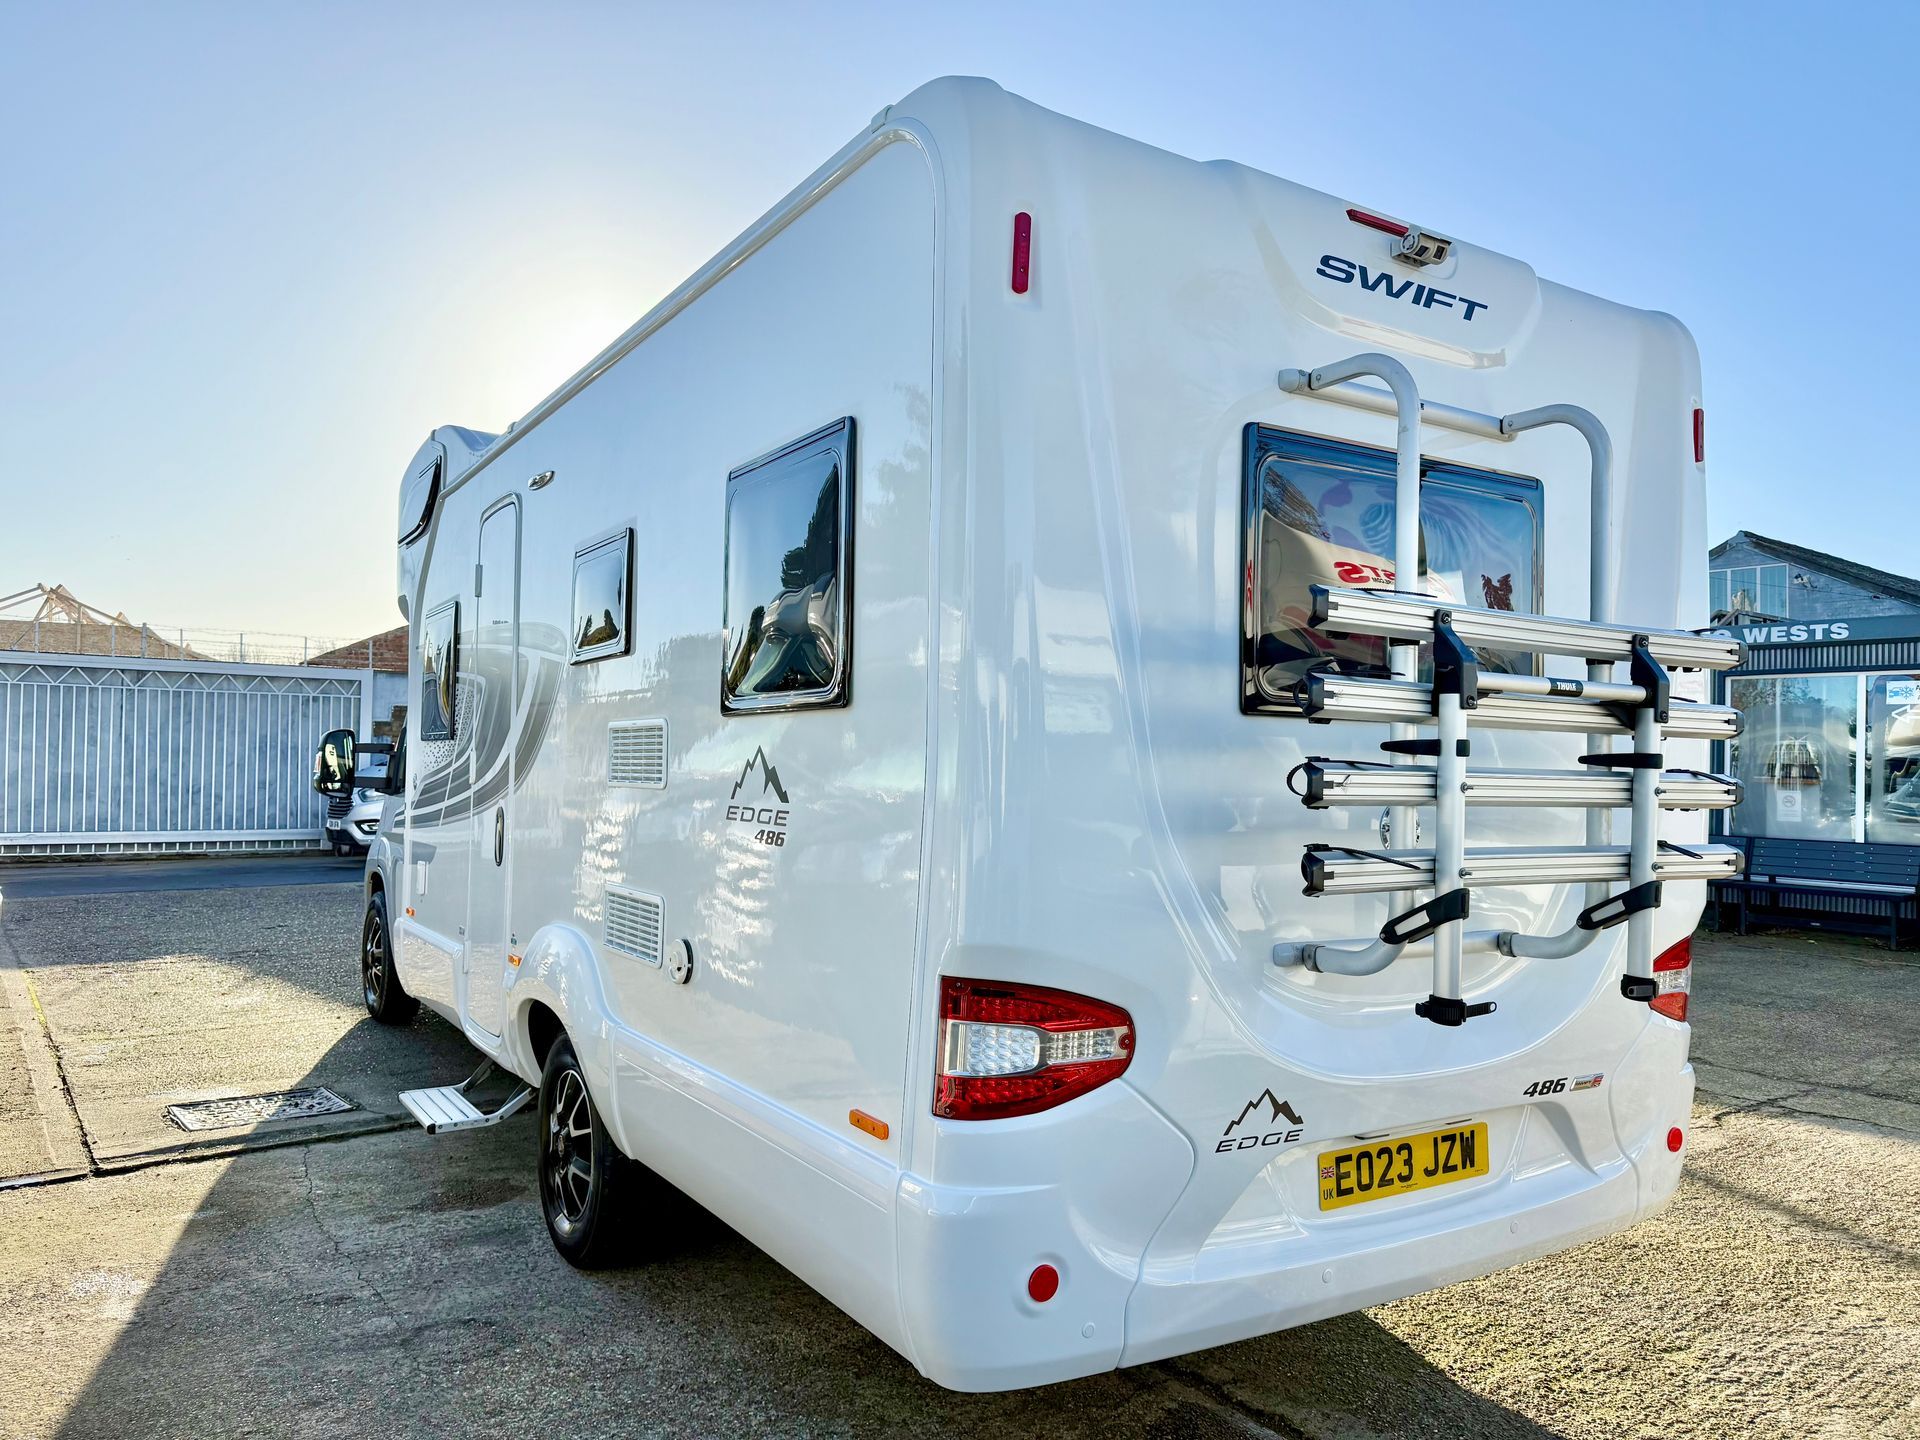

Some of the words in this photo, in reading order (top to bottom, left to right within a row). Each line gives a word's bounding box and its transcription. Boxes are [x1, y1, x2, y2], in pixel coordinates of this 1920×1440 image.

[1316, 254, 1488, 321] SWIFT
[1743, 622, 1850, 644] WESTS
[1556, 681, 1577, 692] THULE
[725, 805, 790, 827] EDGE
[754, 829, 787, 847] 486
[1522, 1077, 1569, 1098] 486
[1214, 1128, 1304, 1153] EDGE
[1334, 1142, 1414, 1198] EO23
[1423, 1129, 1476, 1178] JZW
[1322, 1188, 1335, 1201] UK
